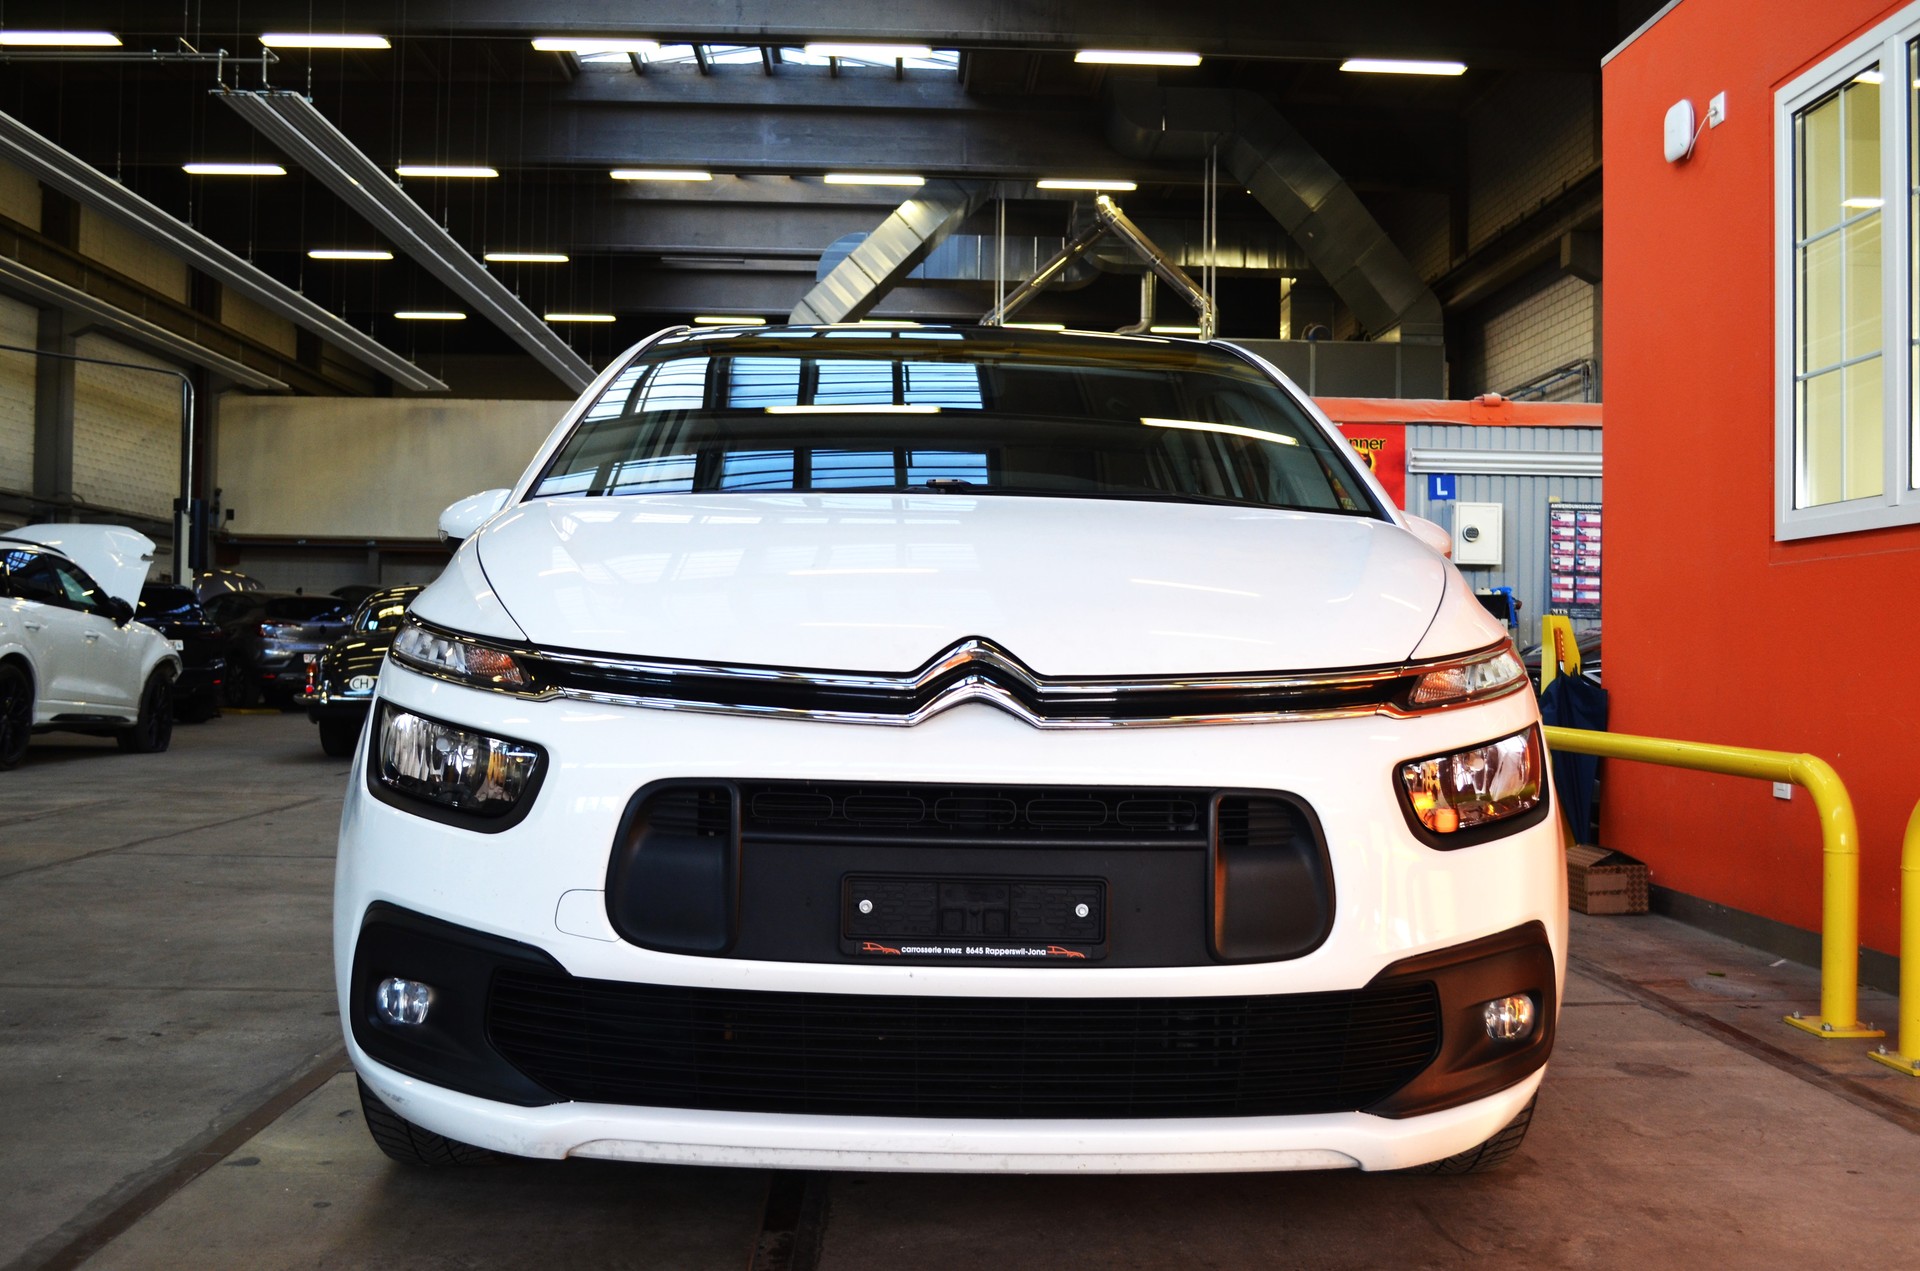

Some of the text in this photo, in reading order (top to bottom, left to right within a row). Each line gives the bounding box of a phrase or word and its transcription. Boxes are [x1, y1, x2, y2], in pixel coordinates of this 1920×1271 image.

[1436, 477, 1448, 496] L
[352, 678, 369, 690] CH
[901, 946, 942, 954] carrosserie
[943, 947, 962, 955] merz
[965, 946, 984, 955] 8645
